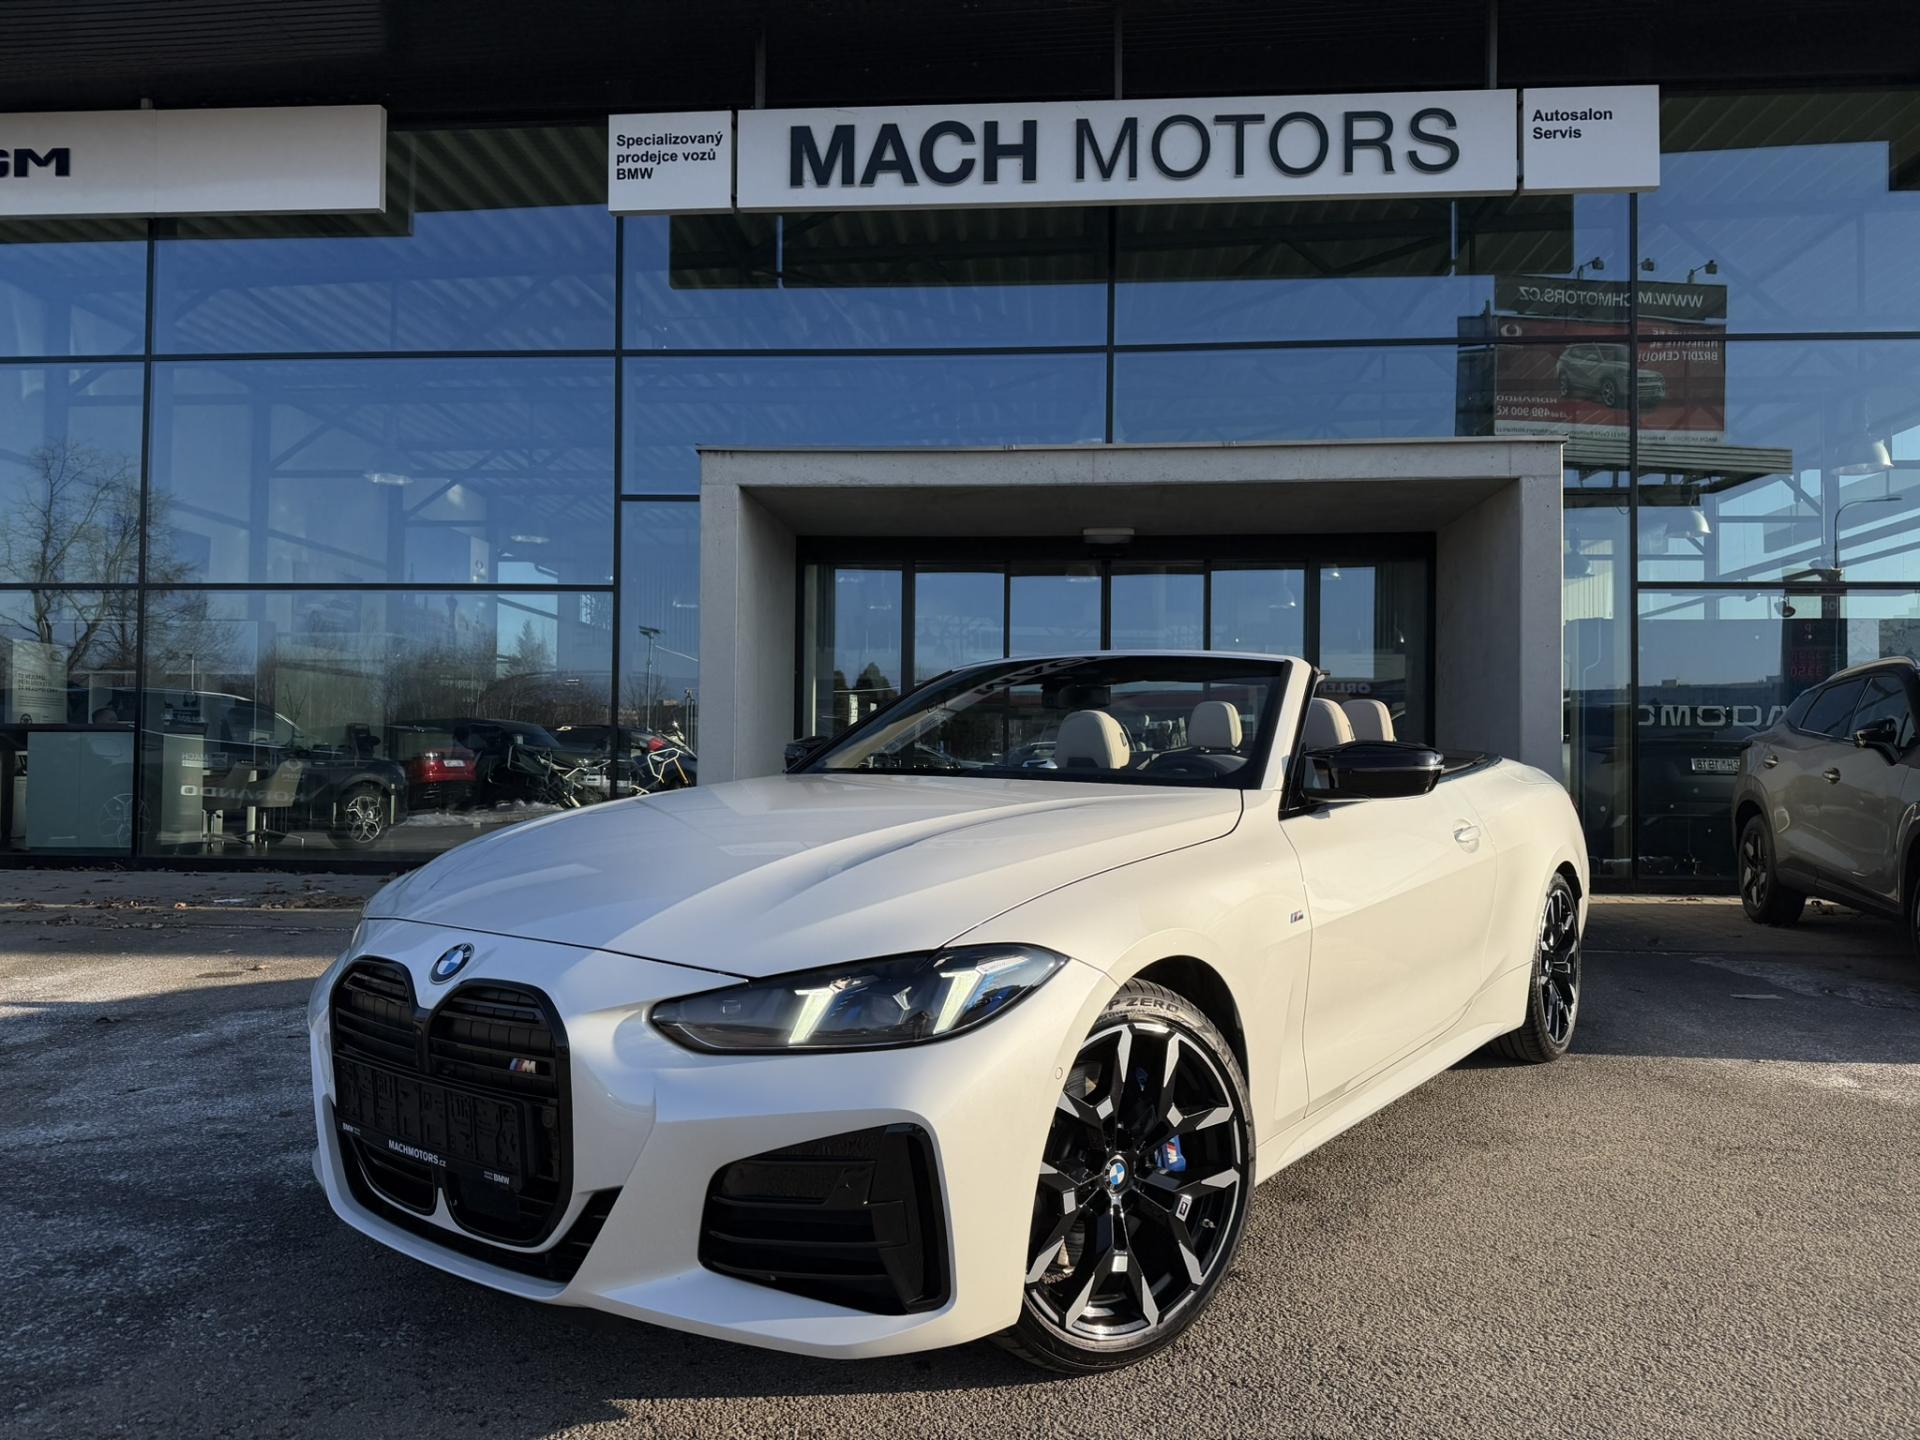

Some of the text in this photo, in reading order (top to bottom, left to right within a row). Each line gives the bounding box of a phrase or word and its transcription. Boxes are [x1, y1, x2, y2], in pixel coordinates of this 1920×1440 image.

[1532, 108, 1613, 122] Autosalon
[616, 131, 723, 149] Specializovaný
[1532, 126, 1582, 140] Servis
[790, 107, 1460, 187] MACH MOTORS
[0, 147, 71, 178] M
[616, 148, 716, 166] prodejce vozů
[616, 167, 654, 180] BMW
[1126, 997, 1180, 1013] ZERO
[493, 1172, 510, 1185] BMW
